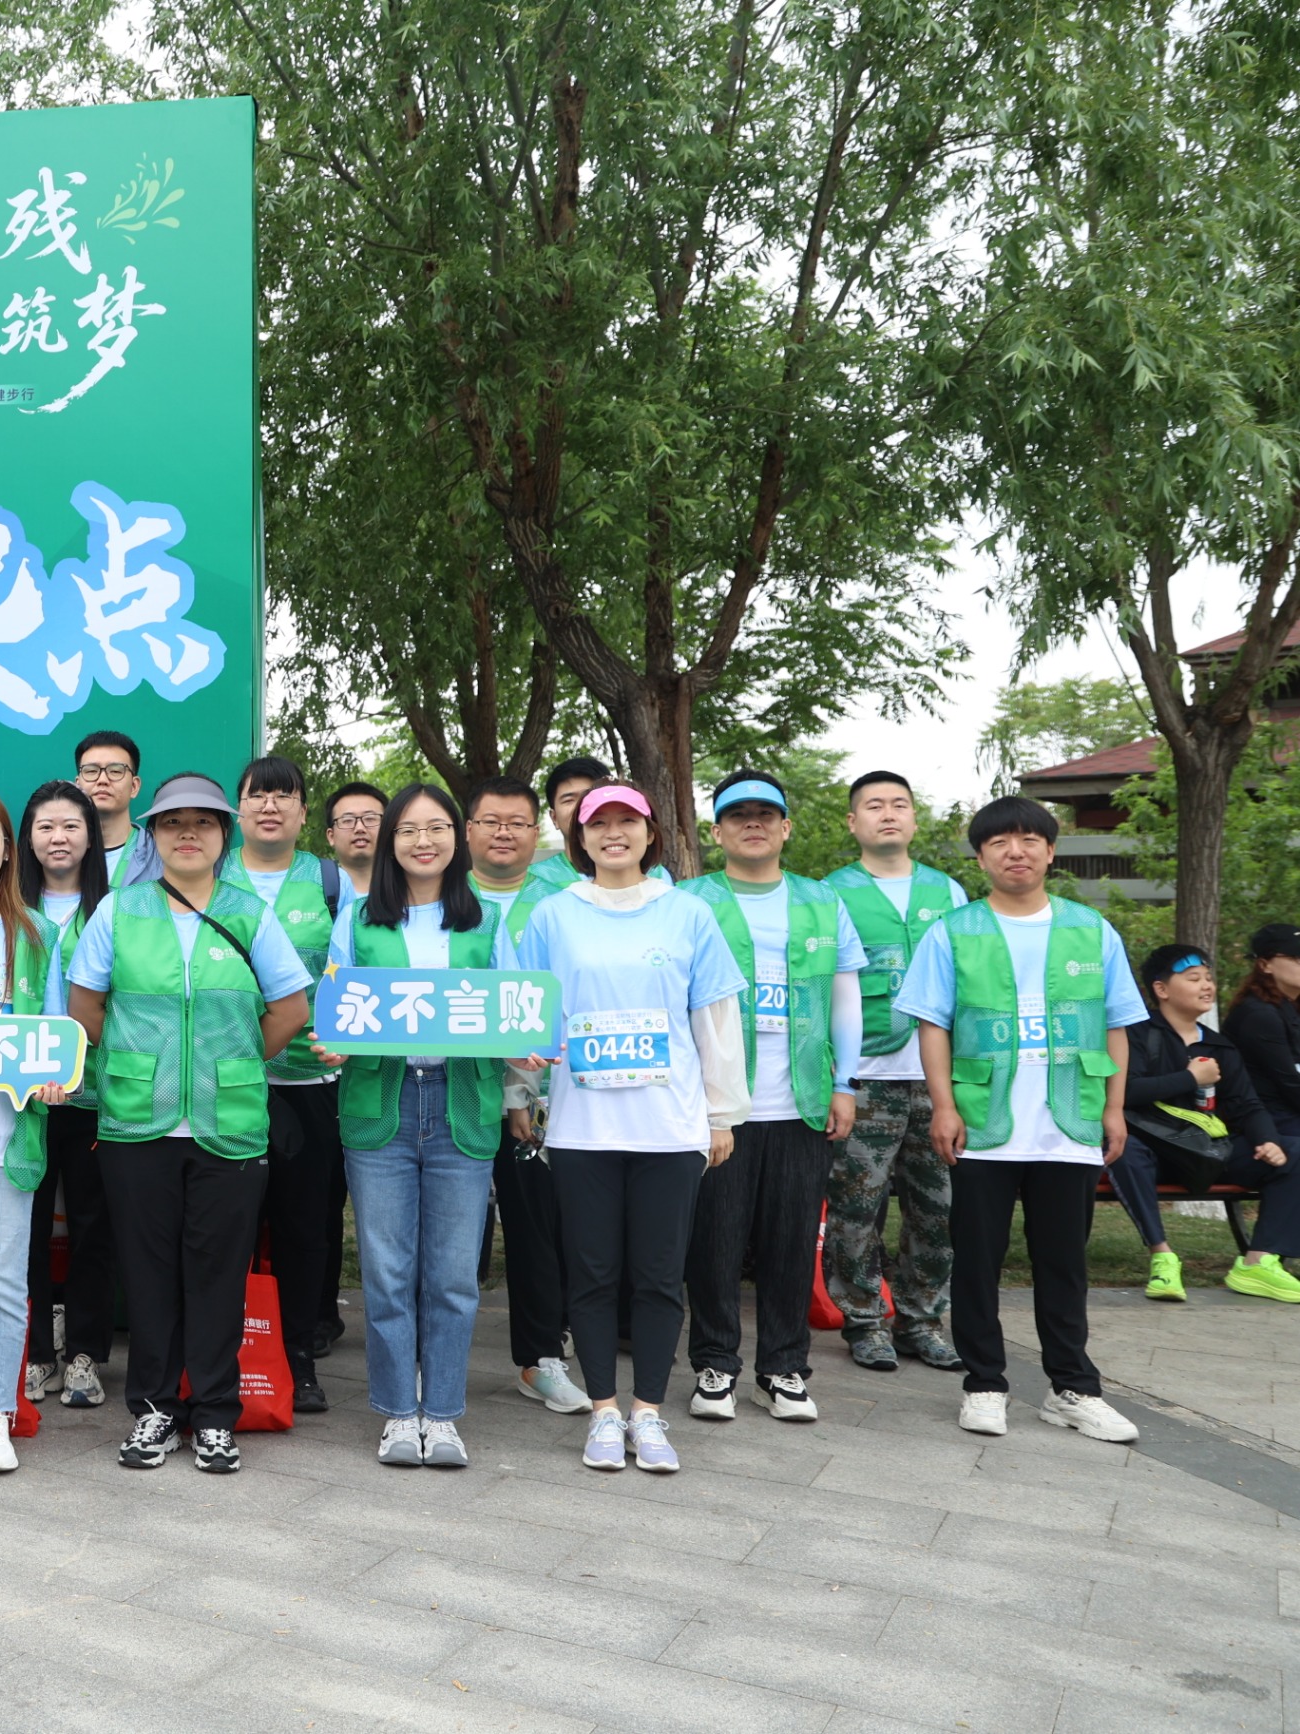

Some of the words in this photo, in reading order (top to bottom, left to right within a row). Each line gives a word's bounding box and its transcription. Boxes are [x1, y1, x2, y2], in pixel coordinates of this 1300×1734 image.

[335, 979, 546, 1036] 永不言败
[584, 1035, 655, 1063] 0448
